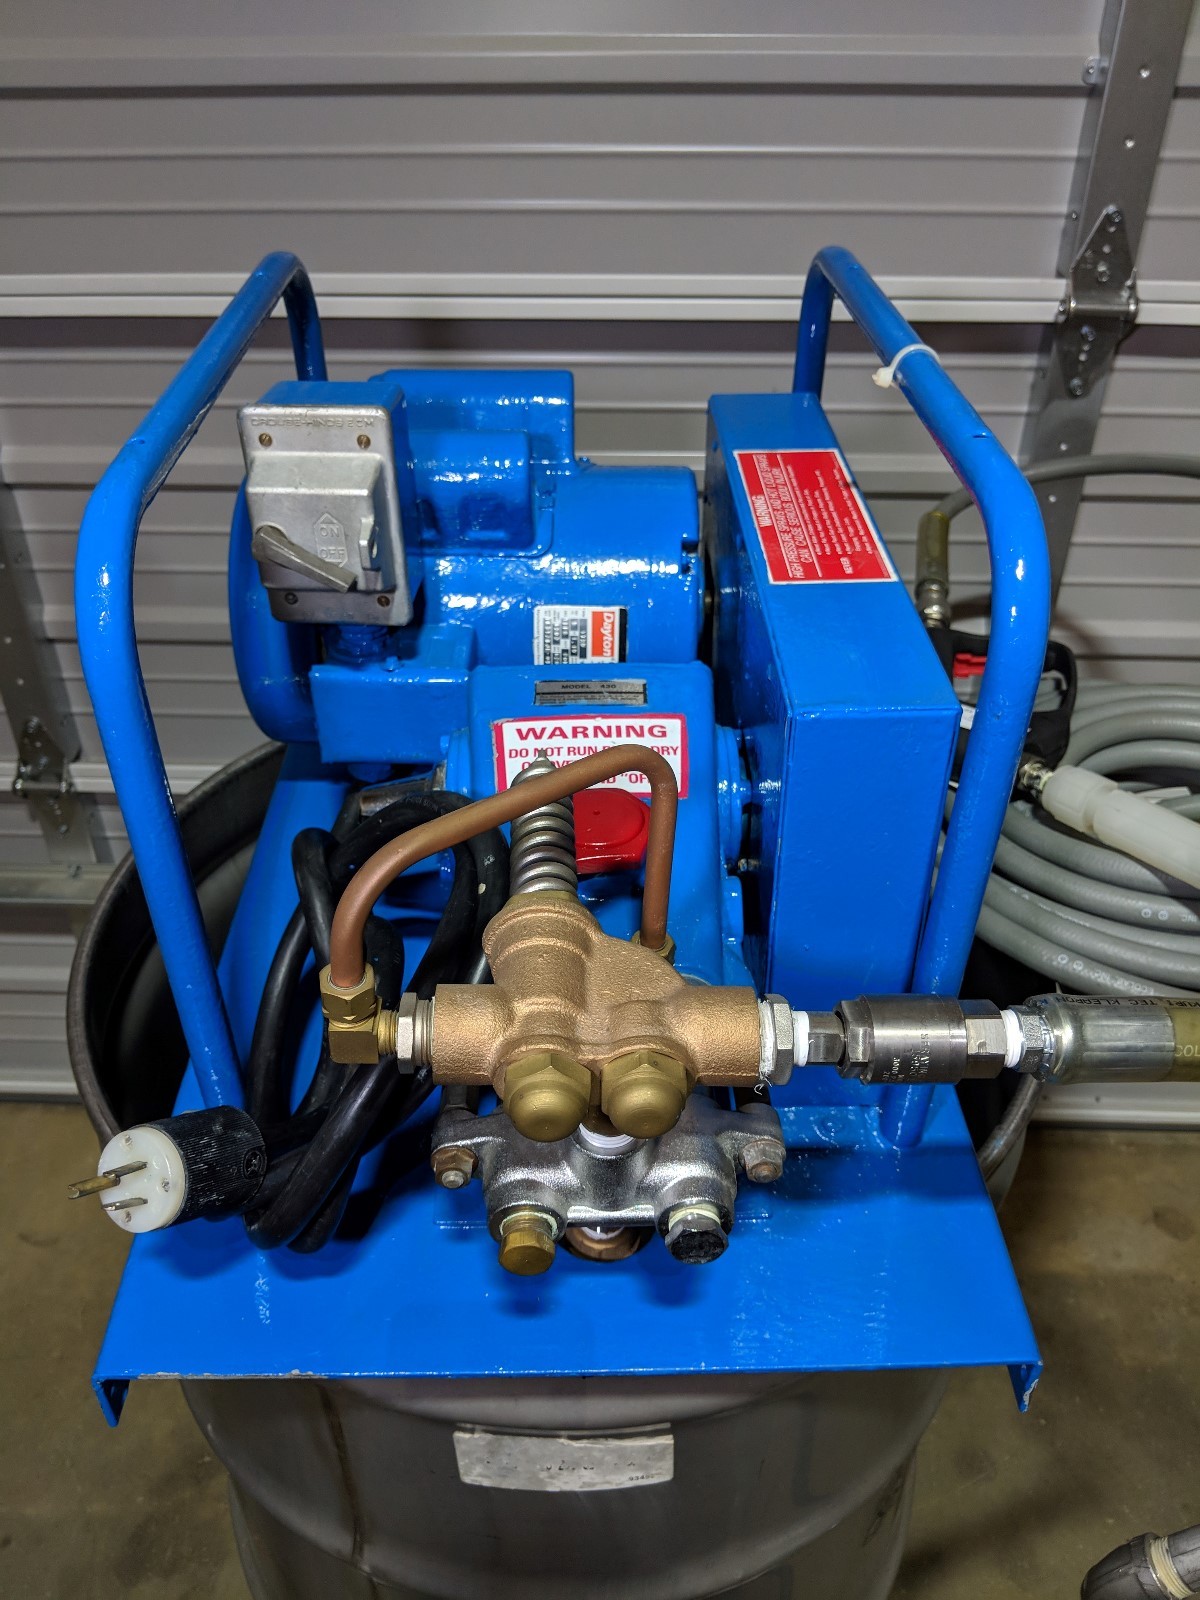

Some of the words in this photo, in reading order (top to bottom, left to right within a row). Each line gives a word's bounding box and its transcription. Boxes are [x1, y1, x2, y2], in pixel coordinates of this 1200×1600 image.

[751, 495, 773, 526] WARNING
[319, 527, 339, 538] ON
[791, 527, 807, 545] CAUSE
[319, 548, 346, 559] OFF
[779, 532, 799, 561] PRESSURE
[601, 612, 615, 657] Dayton
[516, 725, 667, 740] WARNING
[509, 748, 529, 759] DO
[567, 746, 598, 756] RUN
